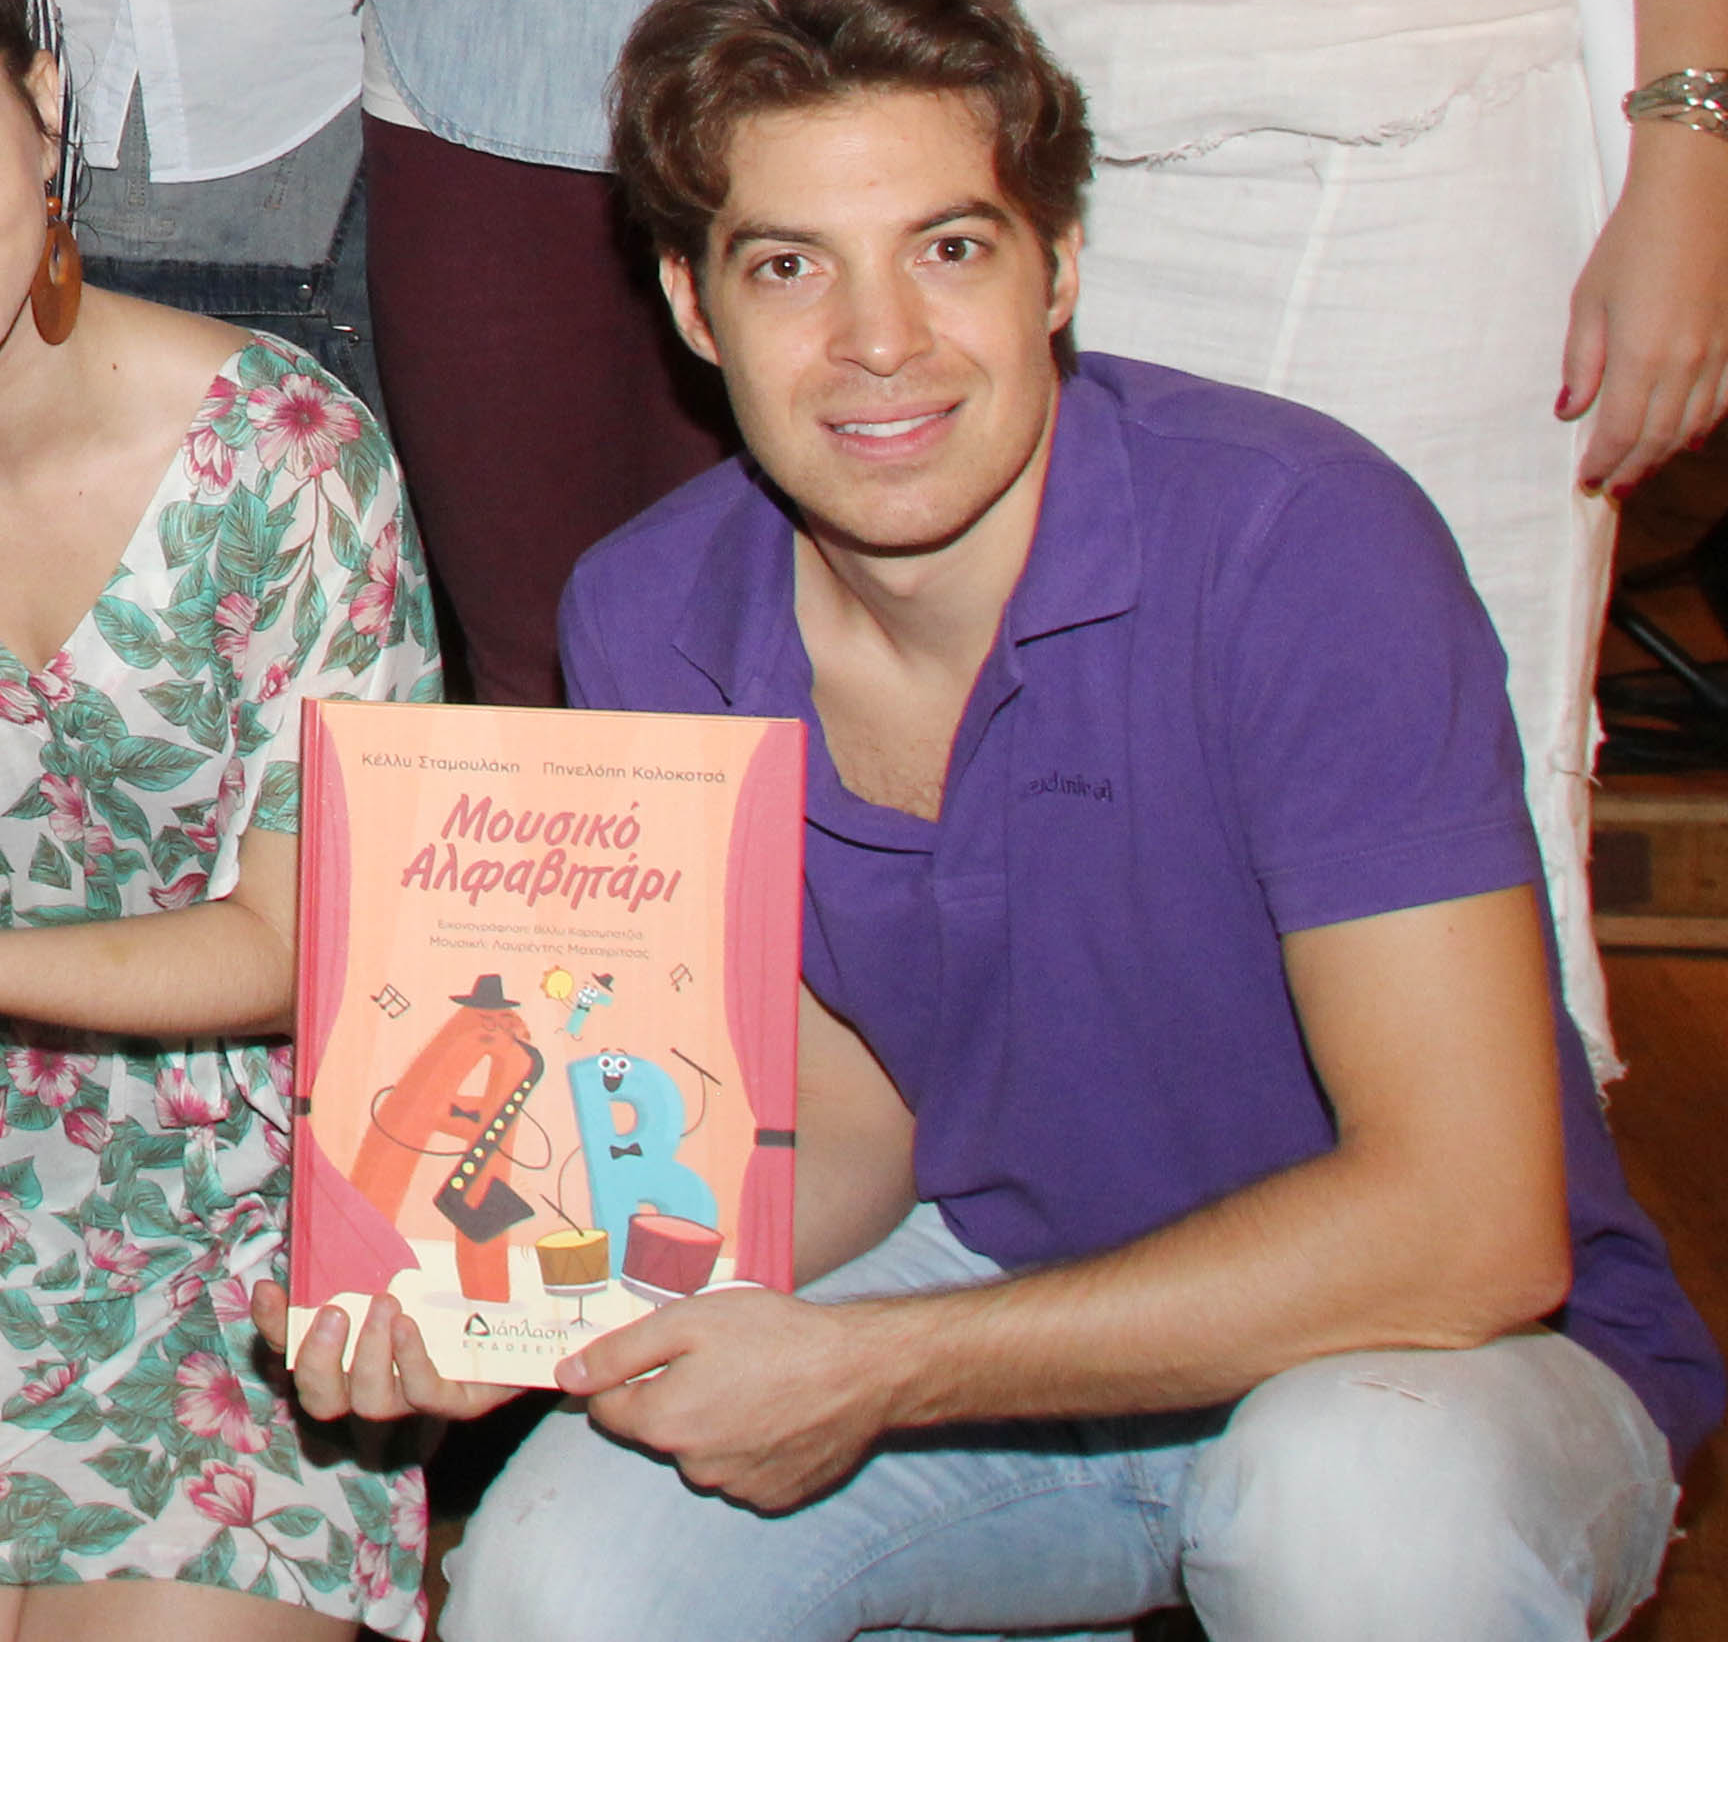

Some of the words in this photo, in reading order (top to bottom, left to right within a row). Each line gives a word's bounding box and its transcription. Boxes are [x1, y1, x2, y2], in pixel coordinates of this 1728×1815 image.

[361, 752, 413, 769] Κέλλυ
[418, 755, 521, 774] Σταμουλάκη
[542, 761, 627, 780] Πηνελόπη
[632, 766, 727, 784] Κολοκοτσά
[440, 792, 642, 851] Μουσικό
[400, 842, 683, 913] Αλφαβητάρι
